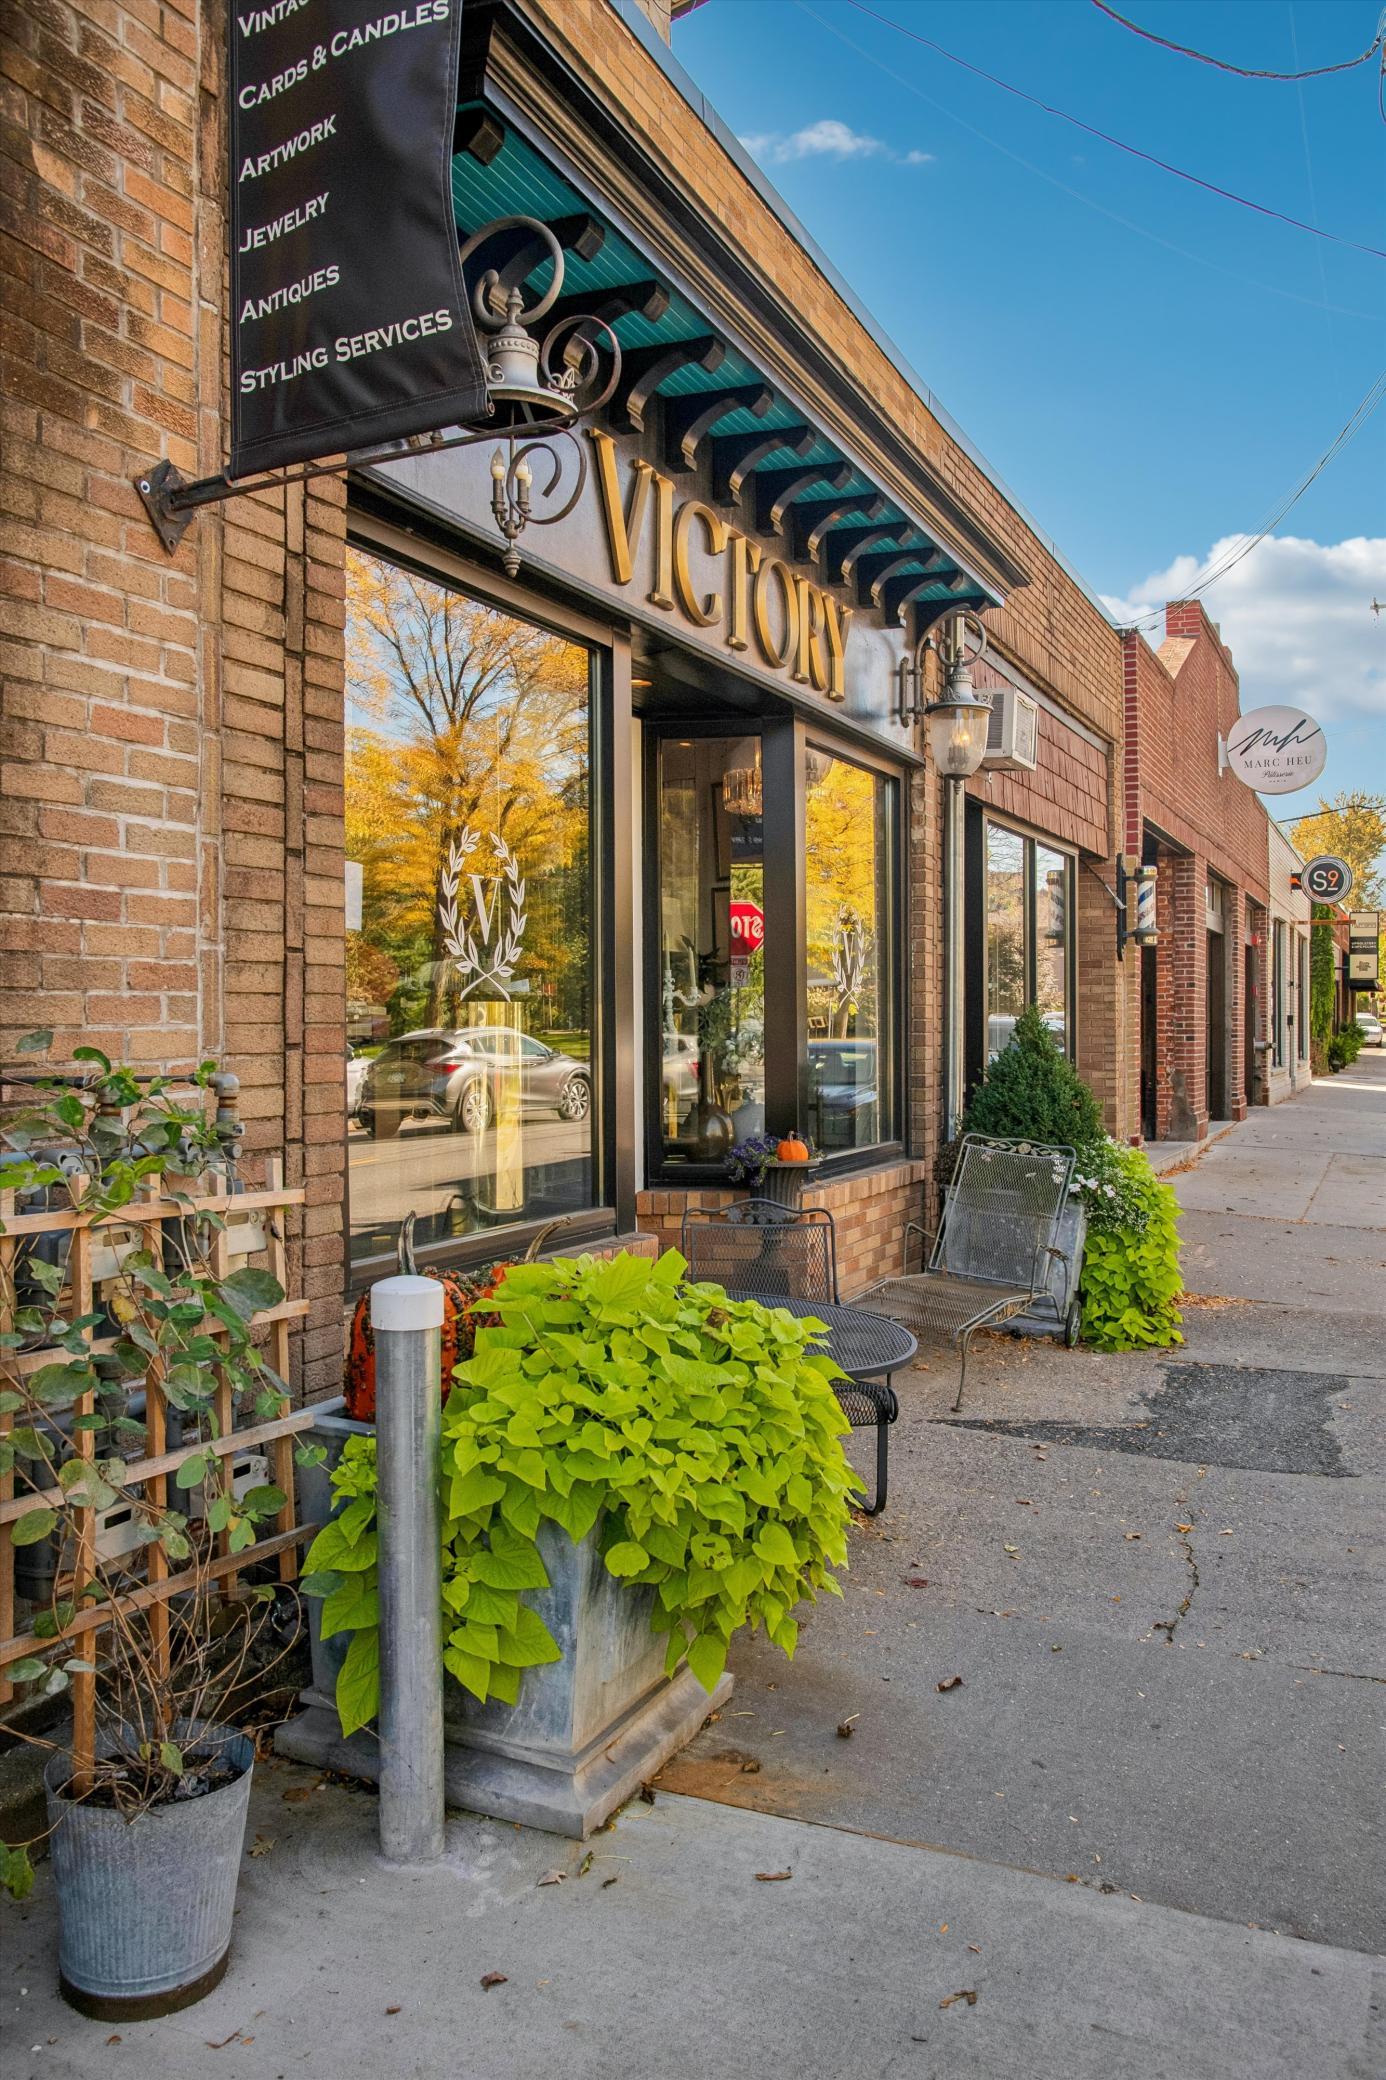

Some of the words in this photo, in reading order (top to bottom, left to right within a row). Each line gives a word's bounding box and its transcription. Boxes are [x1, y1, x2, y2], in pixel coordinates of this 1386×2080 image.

[238, 59, 308, 110] CARDS
[311, 45, 327, 71] &
[330, 0, 450, 57] CANDLES
[239, 113, 337, 183] ARTWORK
[238, 191, 330, 253] JEWELRY
[239, 265, 340, 324] ANTIQUES
[240, 347, 329, 393] STYLING
[334, 309, 453, 362] SERVICES
[586, 427, 854, 702] VICTORY
[1243, 758, 1280, 769] MARC
[1286, 755, 1313, 766] HEU
[1312, 869, 1340, 891] S9
